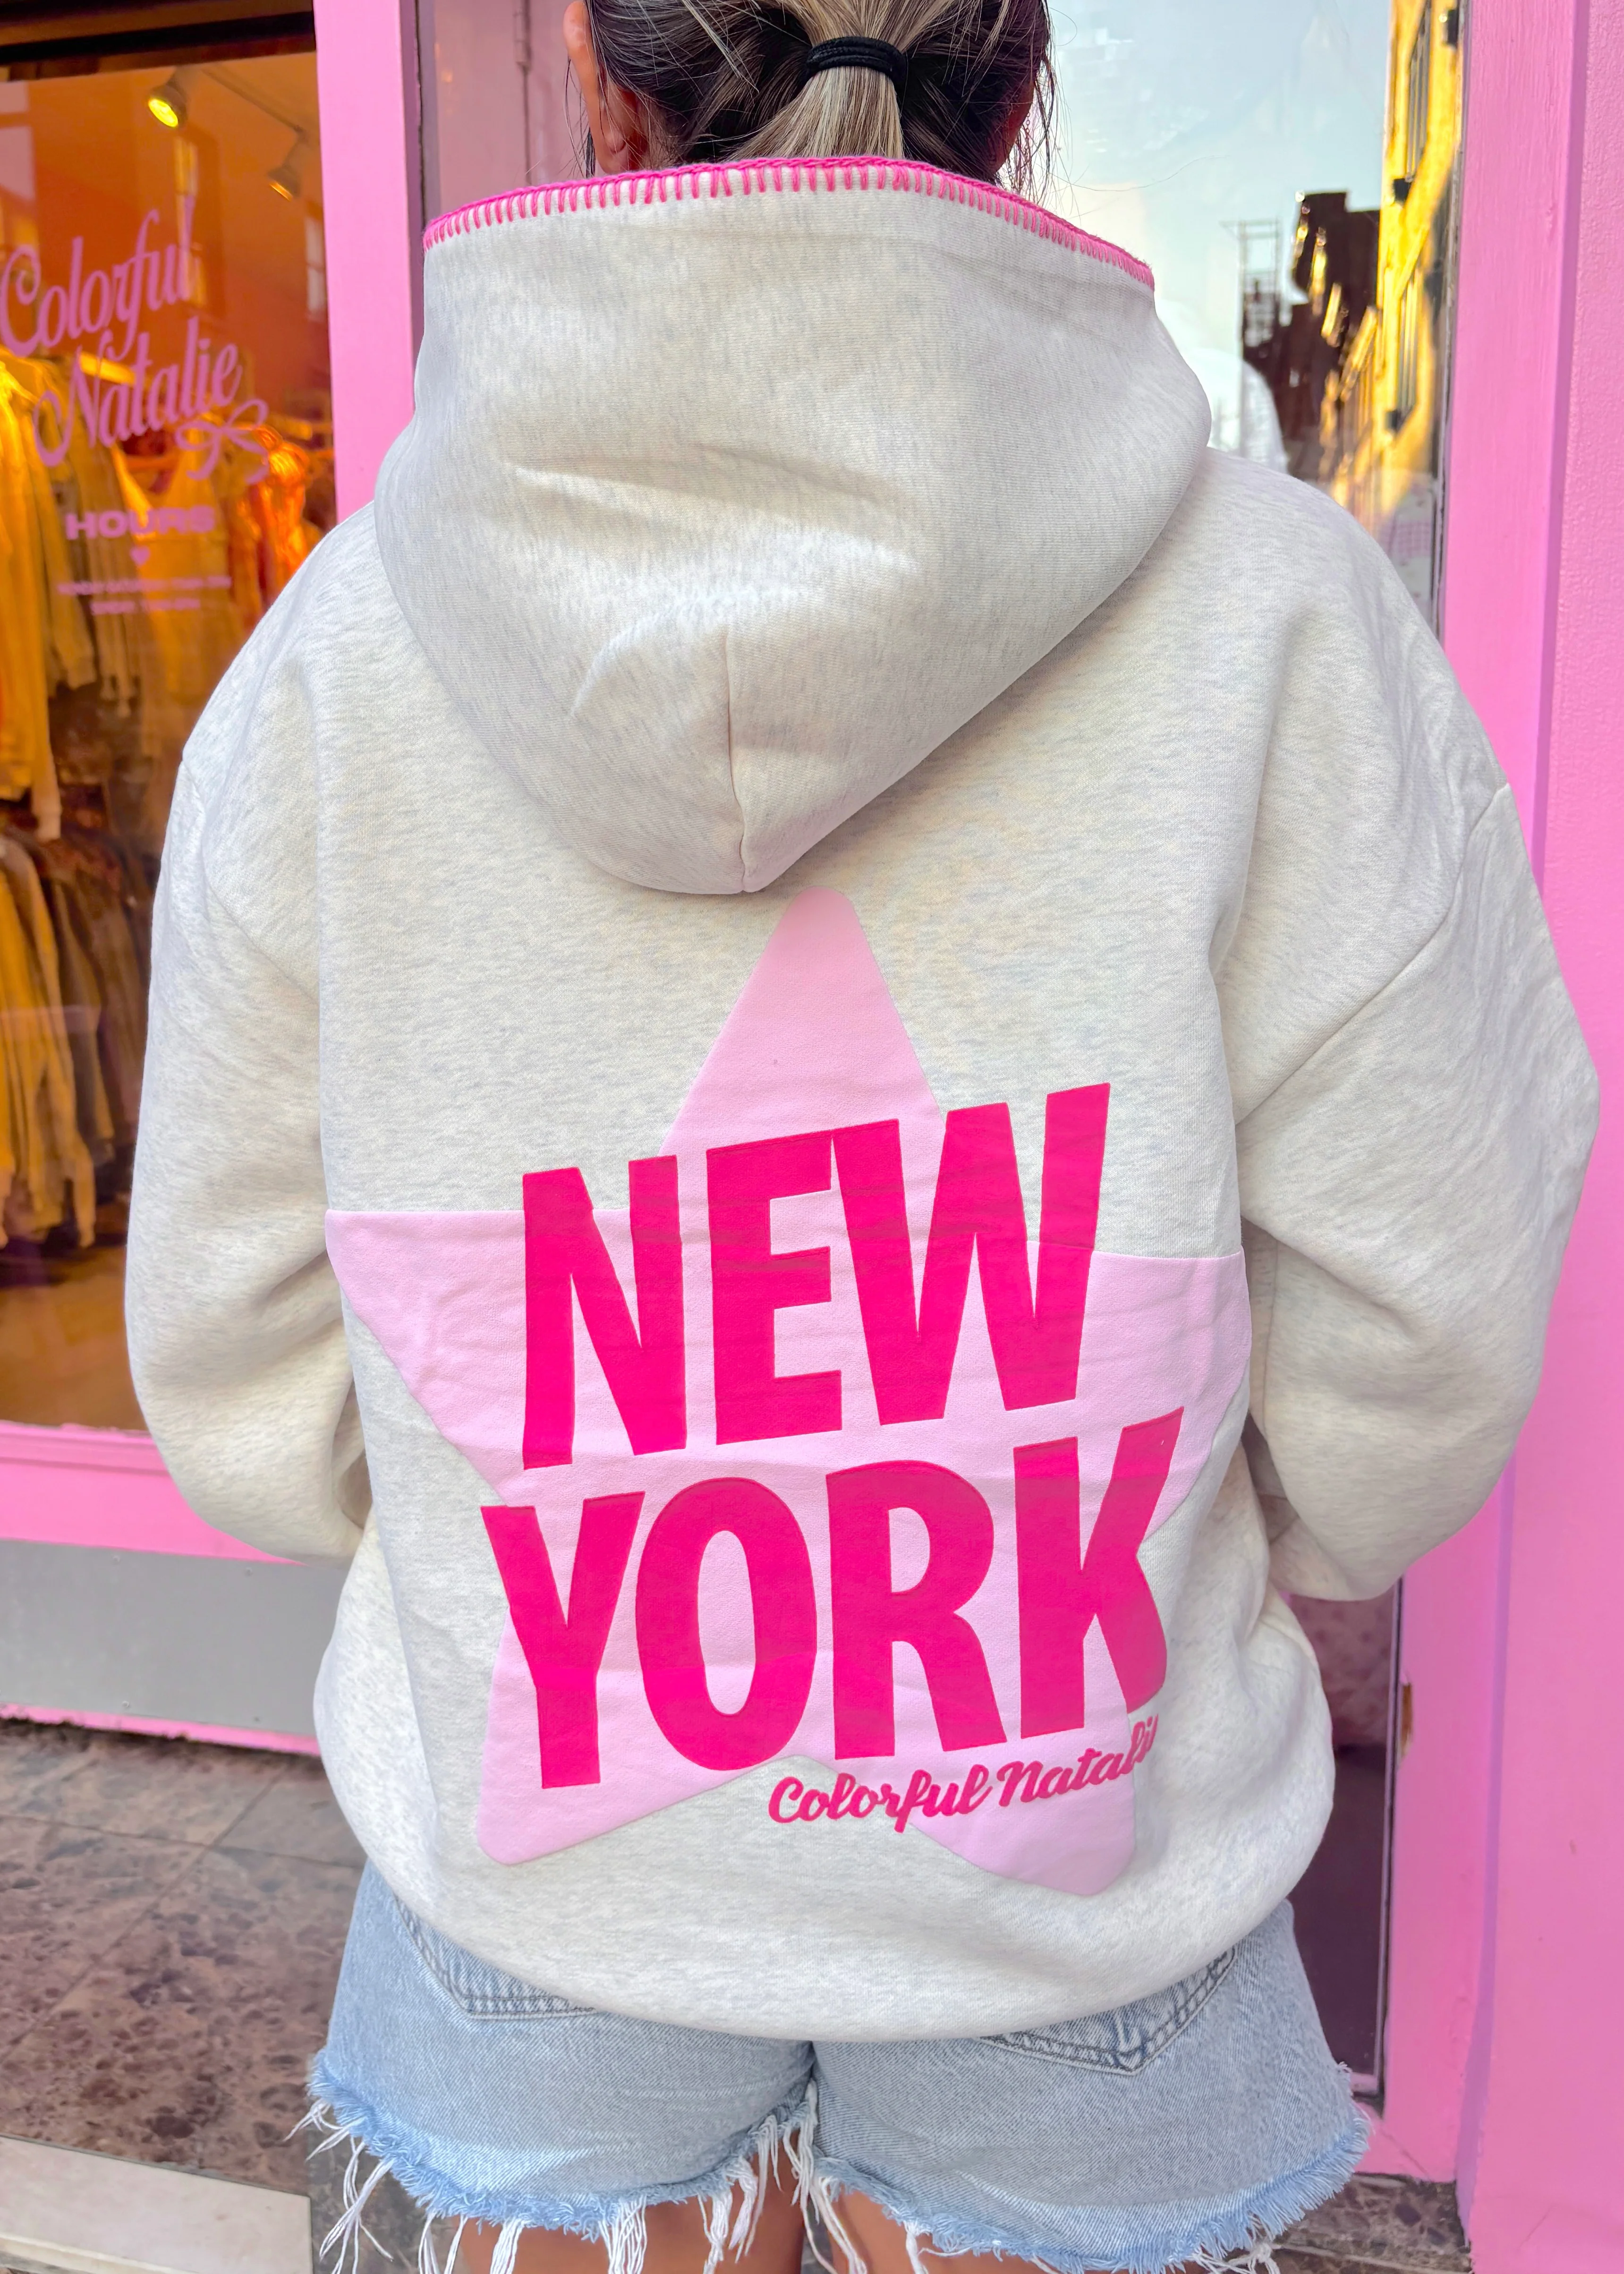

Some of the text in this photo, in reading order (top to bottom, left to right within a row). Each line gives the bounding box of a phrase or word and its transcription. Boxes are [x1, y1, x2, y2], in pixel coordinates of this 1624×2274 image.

[0, 195, 196, 362] Colorful
[33, 316, 243, 467] Natalie
[66, 505, 215, 540] HOURS
[522, 1082, 1111, 1470] NEW
[480, 1406, 1184, 1789] YORK
[768, 1764, 994, 1834] Colorful
